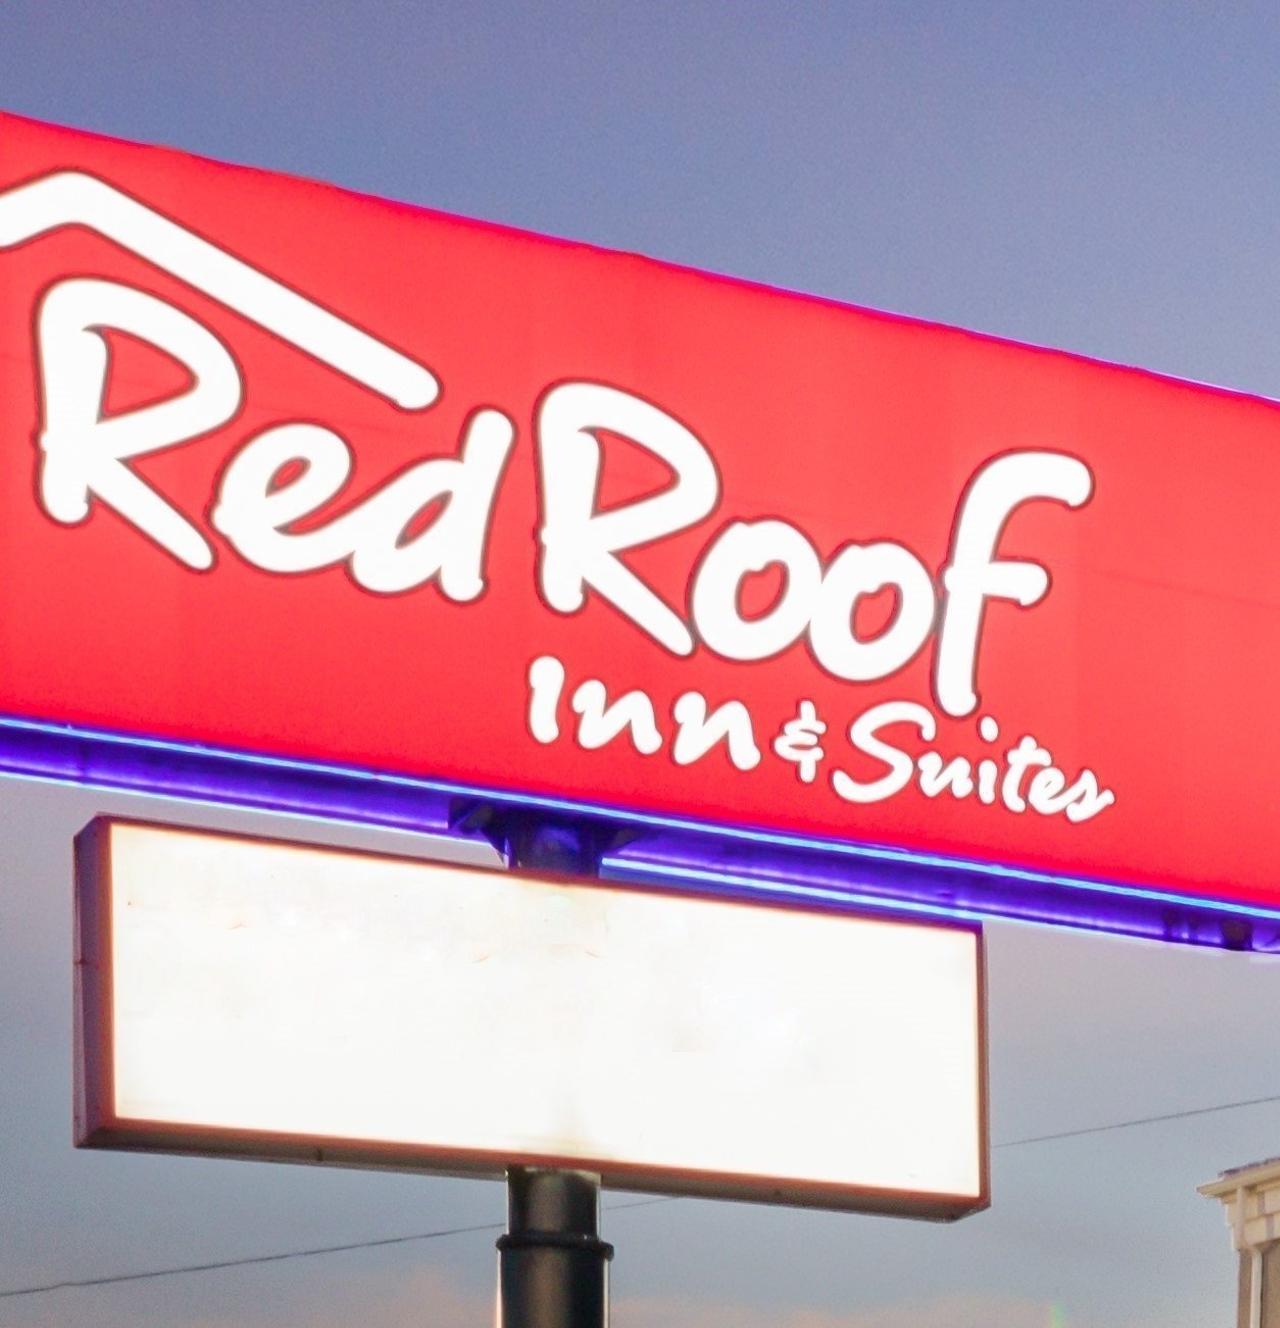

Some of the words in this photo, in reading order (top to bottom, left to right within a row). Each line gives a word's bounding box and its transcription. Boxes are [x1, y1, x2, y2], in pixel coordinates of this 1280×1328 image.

[37, 277, 516, 604] Red
[536, 380, 1093, 719] Roof
[528, 654, 762, 772] Inn
[773, 699, 828, 784] &
[831, 700, 1116, 823] Suites
